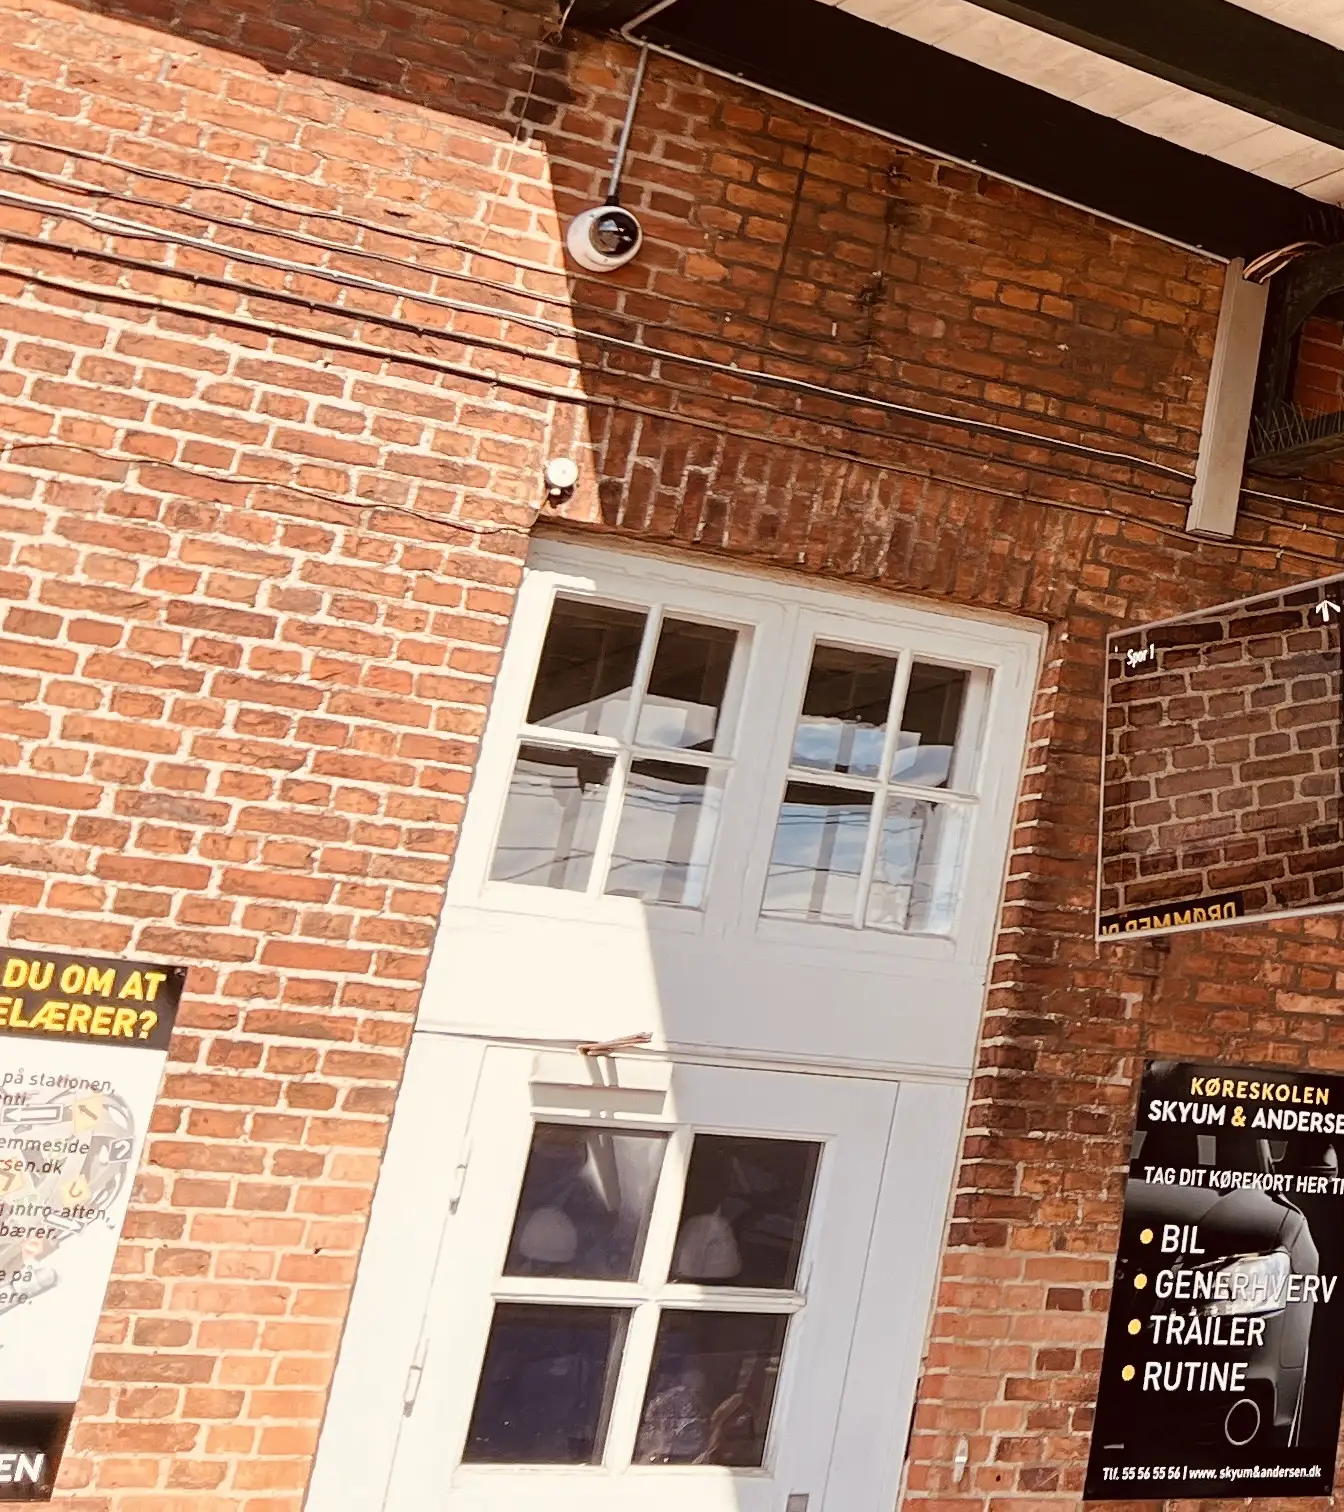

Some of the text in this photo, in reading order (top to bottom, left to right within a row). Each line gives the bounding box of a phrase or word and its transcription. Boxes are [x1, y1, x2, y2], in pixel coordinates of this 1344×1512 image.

[1126, 643, 1155, 668] Spor 1
[2, 958, 167, 1002] DU OM AT
[1, 1067, 116, 1096] på stationen,
[1190, 1076, 1330, 1106] KØRESKOLEN
[0, 1091, 30, 1108] nti.
[1148, 1099, 1227, 1126] SKYUM
[1231, 1105, 1248, 1128] &
[1144, 1165, 1176, 1186] TAG
[1179, 1168, 1207, 1187] DIT
[1209, 1170, 1294, 1191] KØREKORT
[1296, 1175, 1329, 1194] HER
[10, 1202, 110, 1225] intro-aften,
[1160, 1224, 1206, 1255] BIL
[10, 1264, 33, 1285] på
[1154, 1269, 1338, 1304] GENERHVERV
[1149, 1314, 1267, 1347] TRAILER
[1142, 1361, 1249, 1392] RUTINE
[1122, 1466, 1136, 1480] 55
[1136, 1467, 1151, 1480] 56
[1152, 1466, 1167, 1480] 55
[1167, 1466, 1181, 1480] 56
[1188, 1468, 1218, 1479] www.
[1219, 1464, 1322, 1482] skyum&andersen.dk
